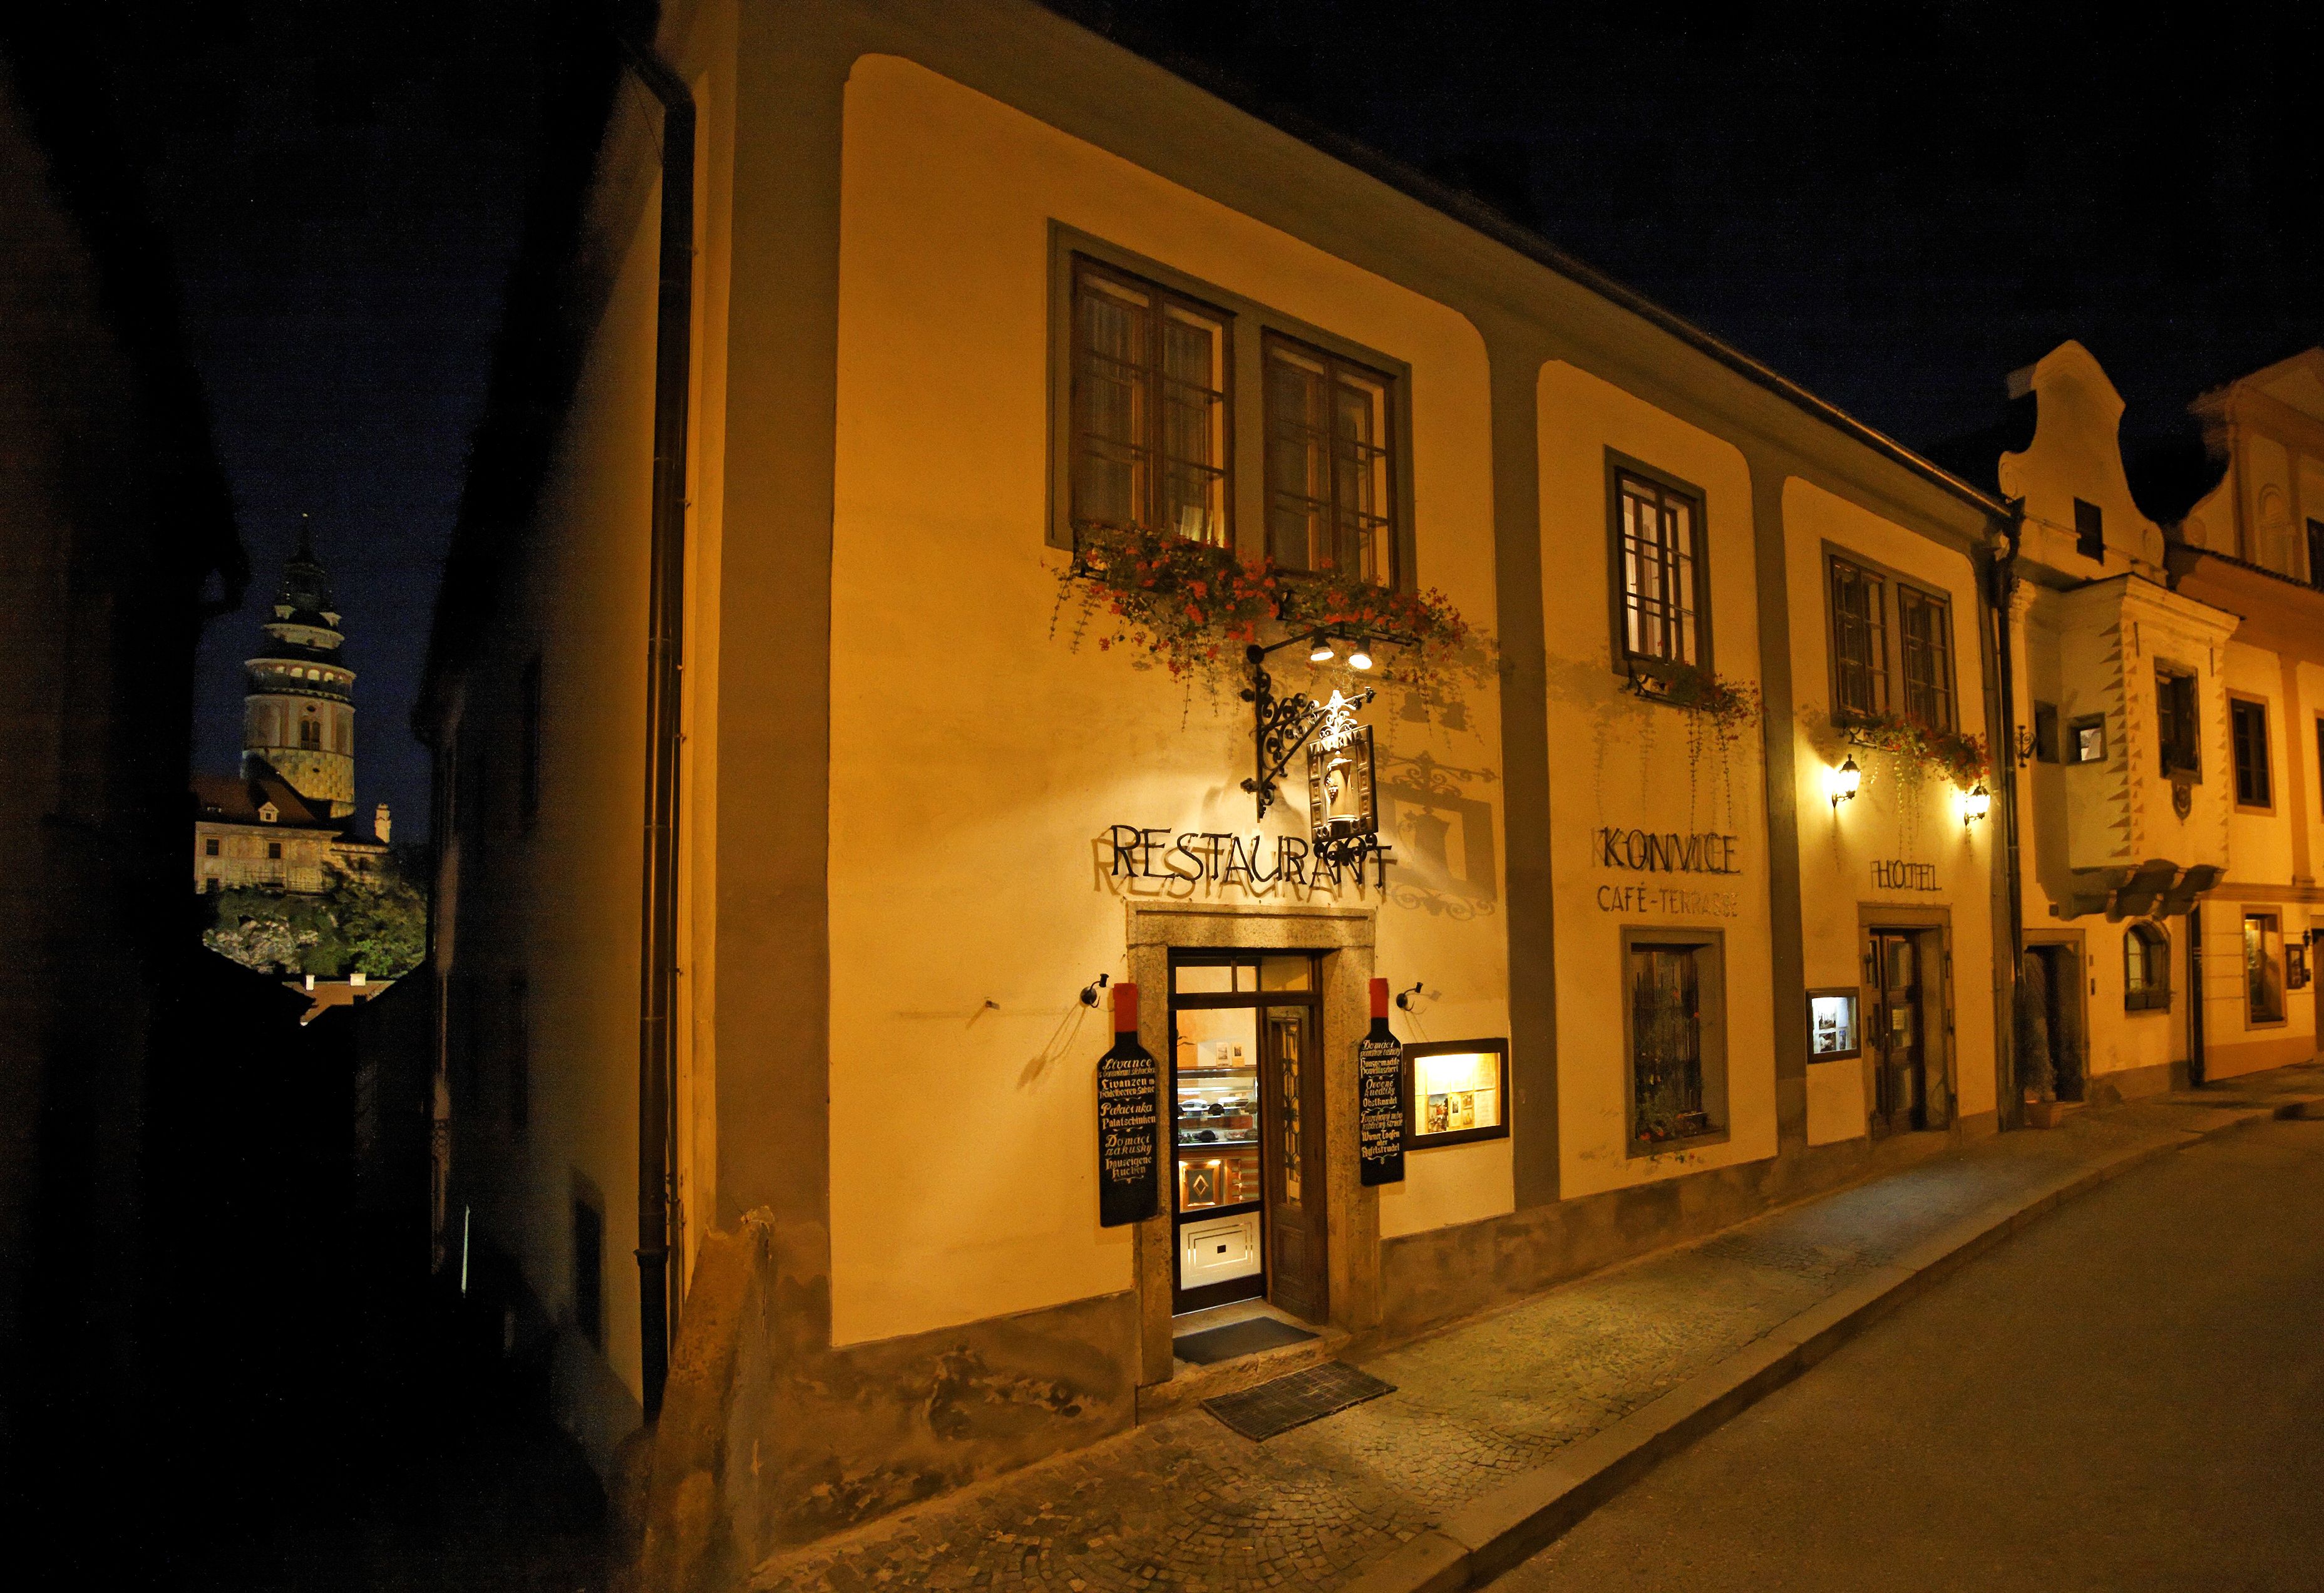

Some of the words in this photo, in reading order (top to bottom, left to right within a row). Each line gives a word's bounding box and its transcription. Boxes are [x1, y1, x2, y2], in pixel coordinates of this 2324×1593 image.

[1111, 825, 1392, 888] RESTAURANT
[1600, 826, 1741, 874] KONVICE
[1877, 859, 1942, 890] HOTEL
